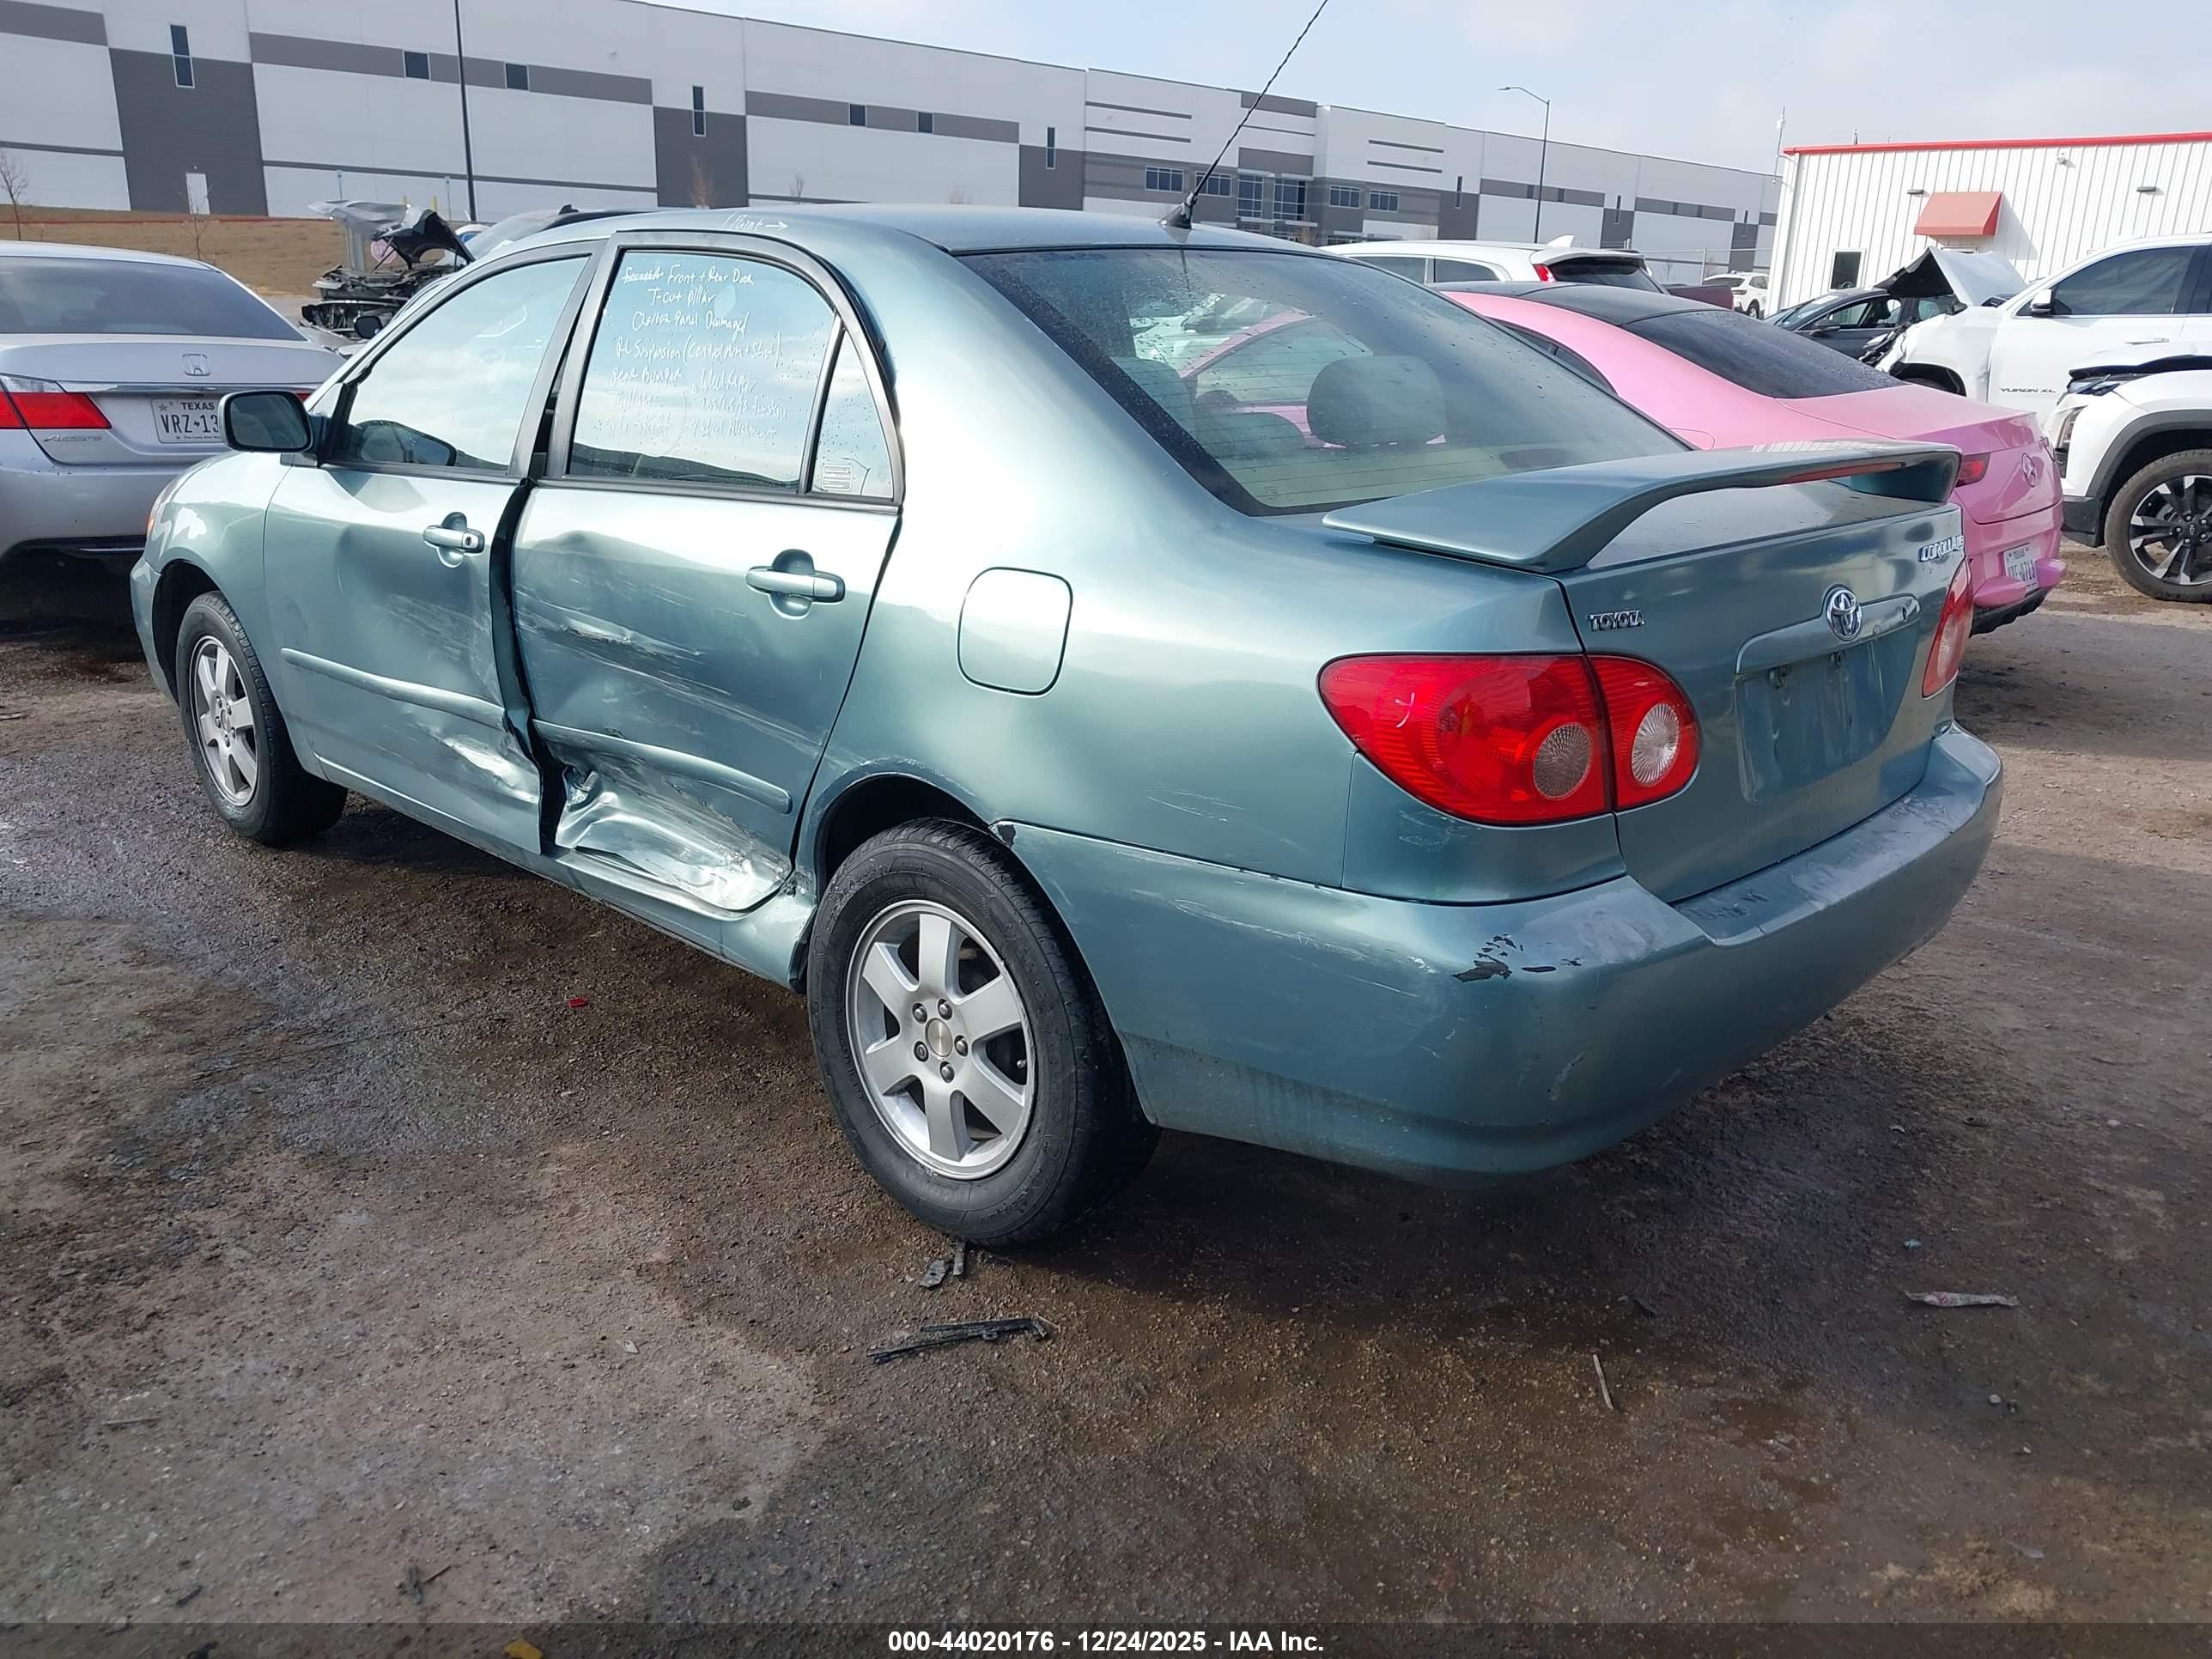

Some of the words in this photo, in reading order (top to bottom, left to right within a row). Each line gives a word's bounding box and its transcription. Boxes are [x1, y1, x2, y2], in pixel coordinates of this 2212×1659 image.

[667, 264, 696, 284] Front
[180, 402, 215, 410] TEXAS
[1587, 610, 1645, 631] TOYOTA
